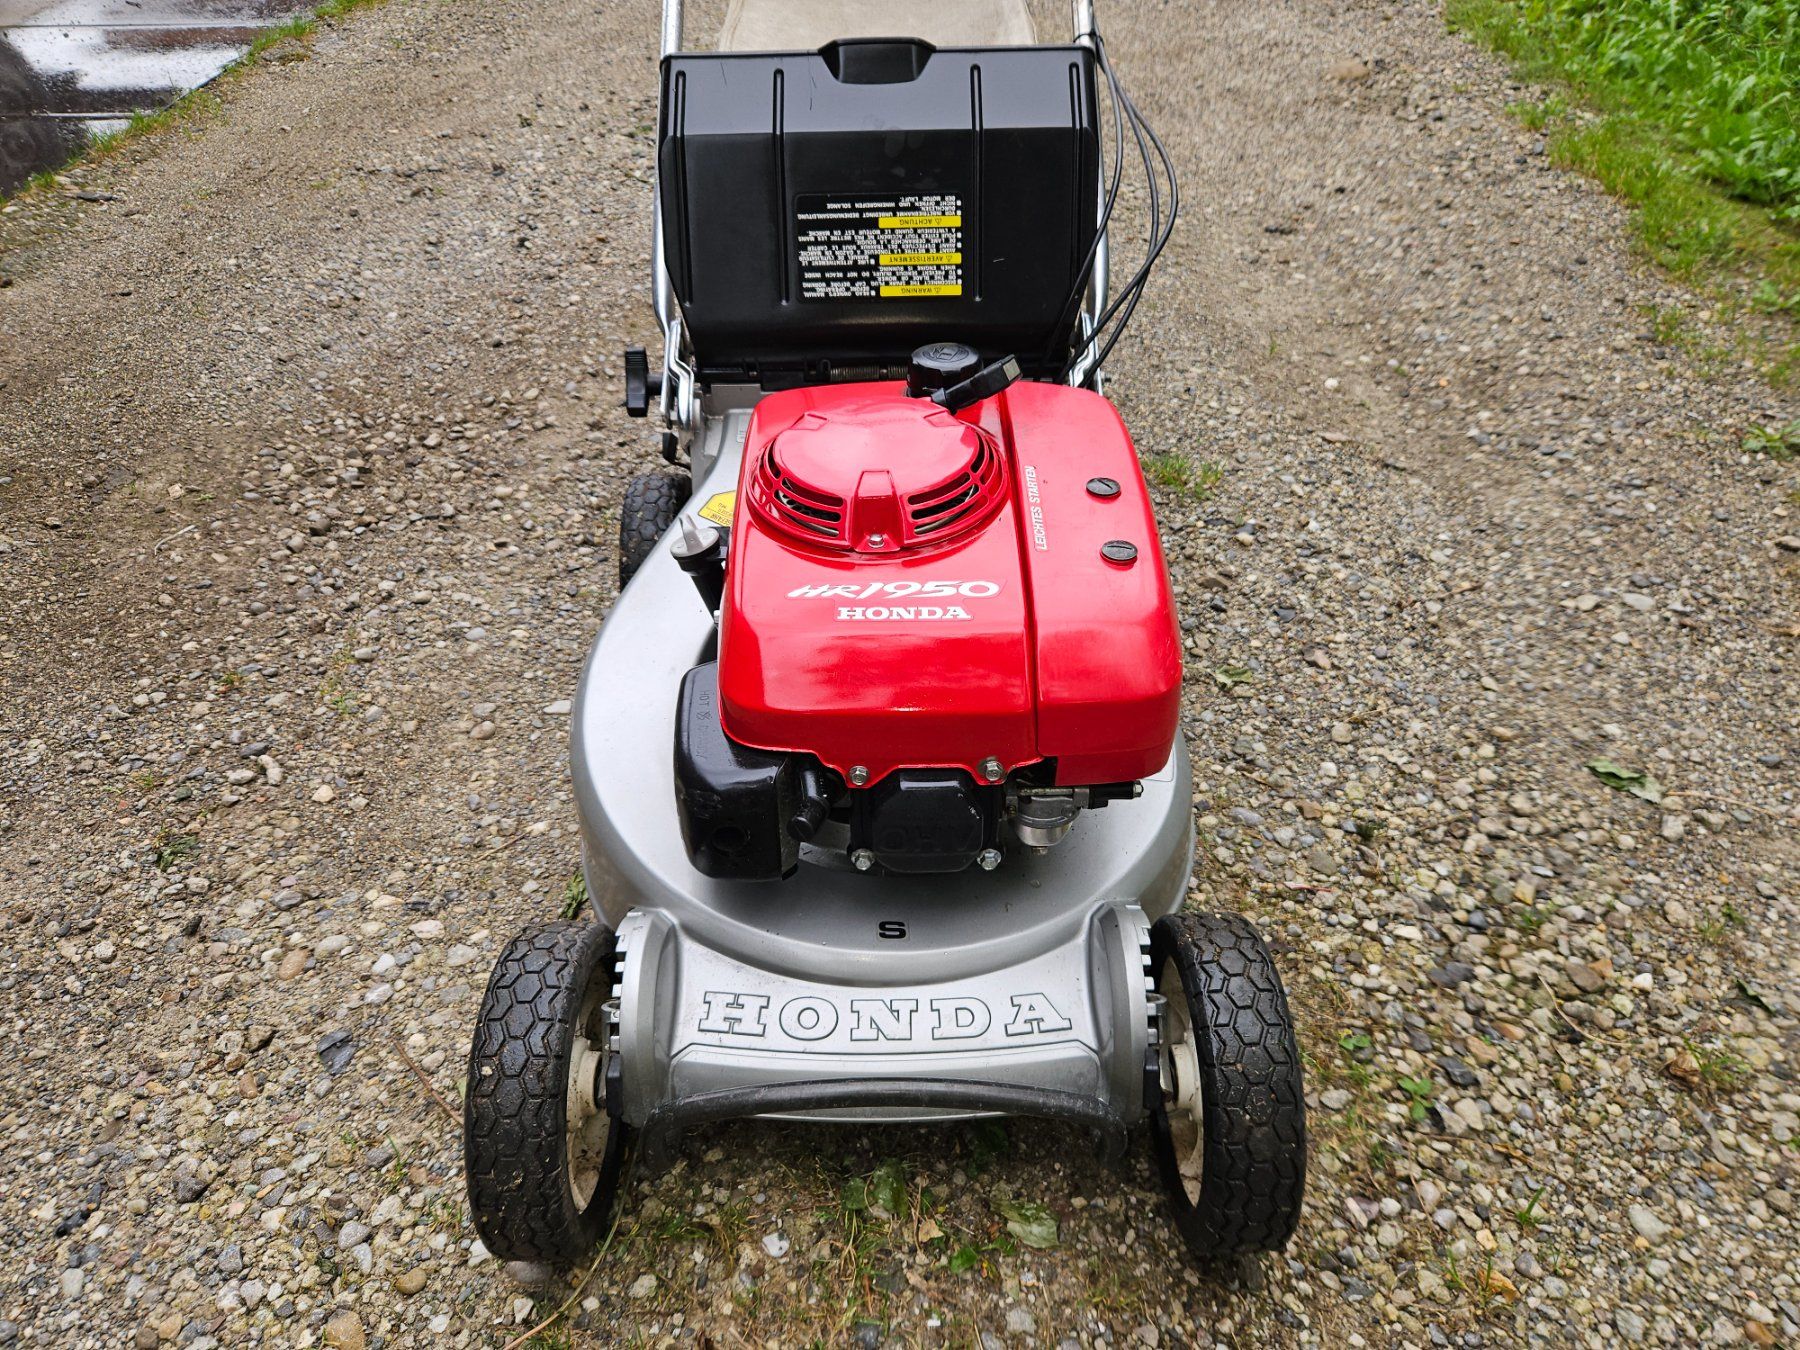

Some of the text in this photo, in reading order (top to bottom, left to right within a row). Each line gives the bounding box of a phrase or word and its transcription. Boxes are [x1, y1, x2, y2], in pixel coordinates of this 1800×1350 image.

[1025, 466, 1047, 550] LEICHTES STARTEN
[787, 580, 1000, 599] HR1950
[837, 606, 972, 620] HONDA
[878, 921, 907, 939] S
[698, 991, 1073, 1042] HONDA
